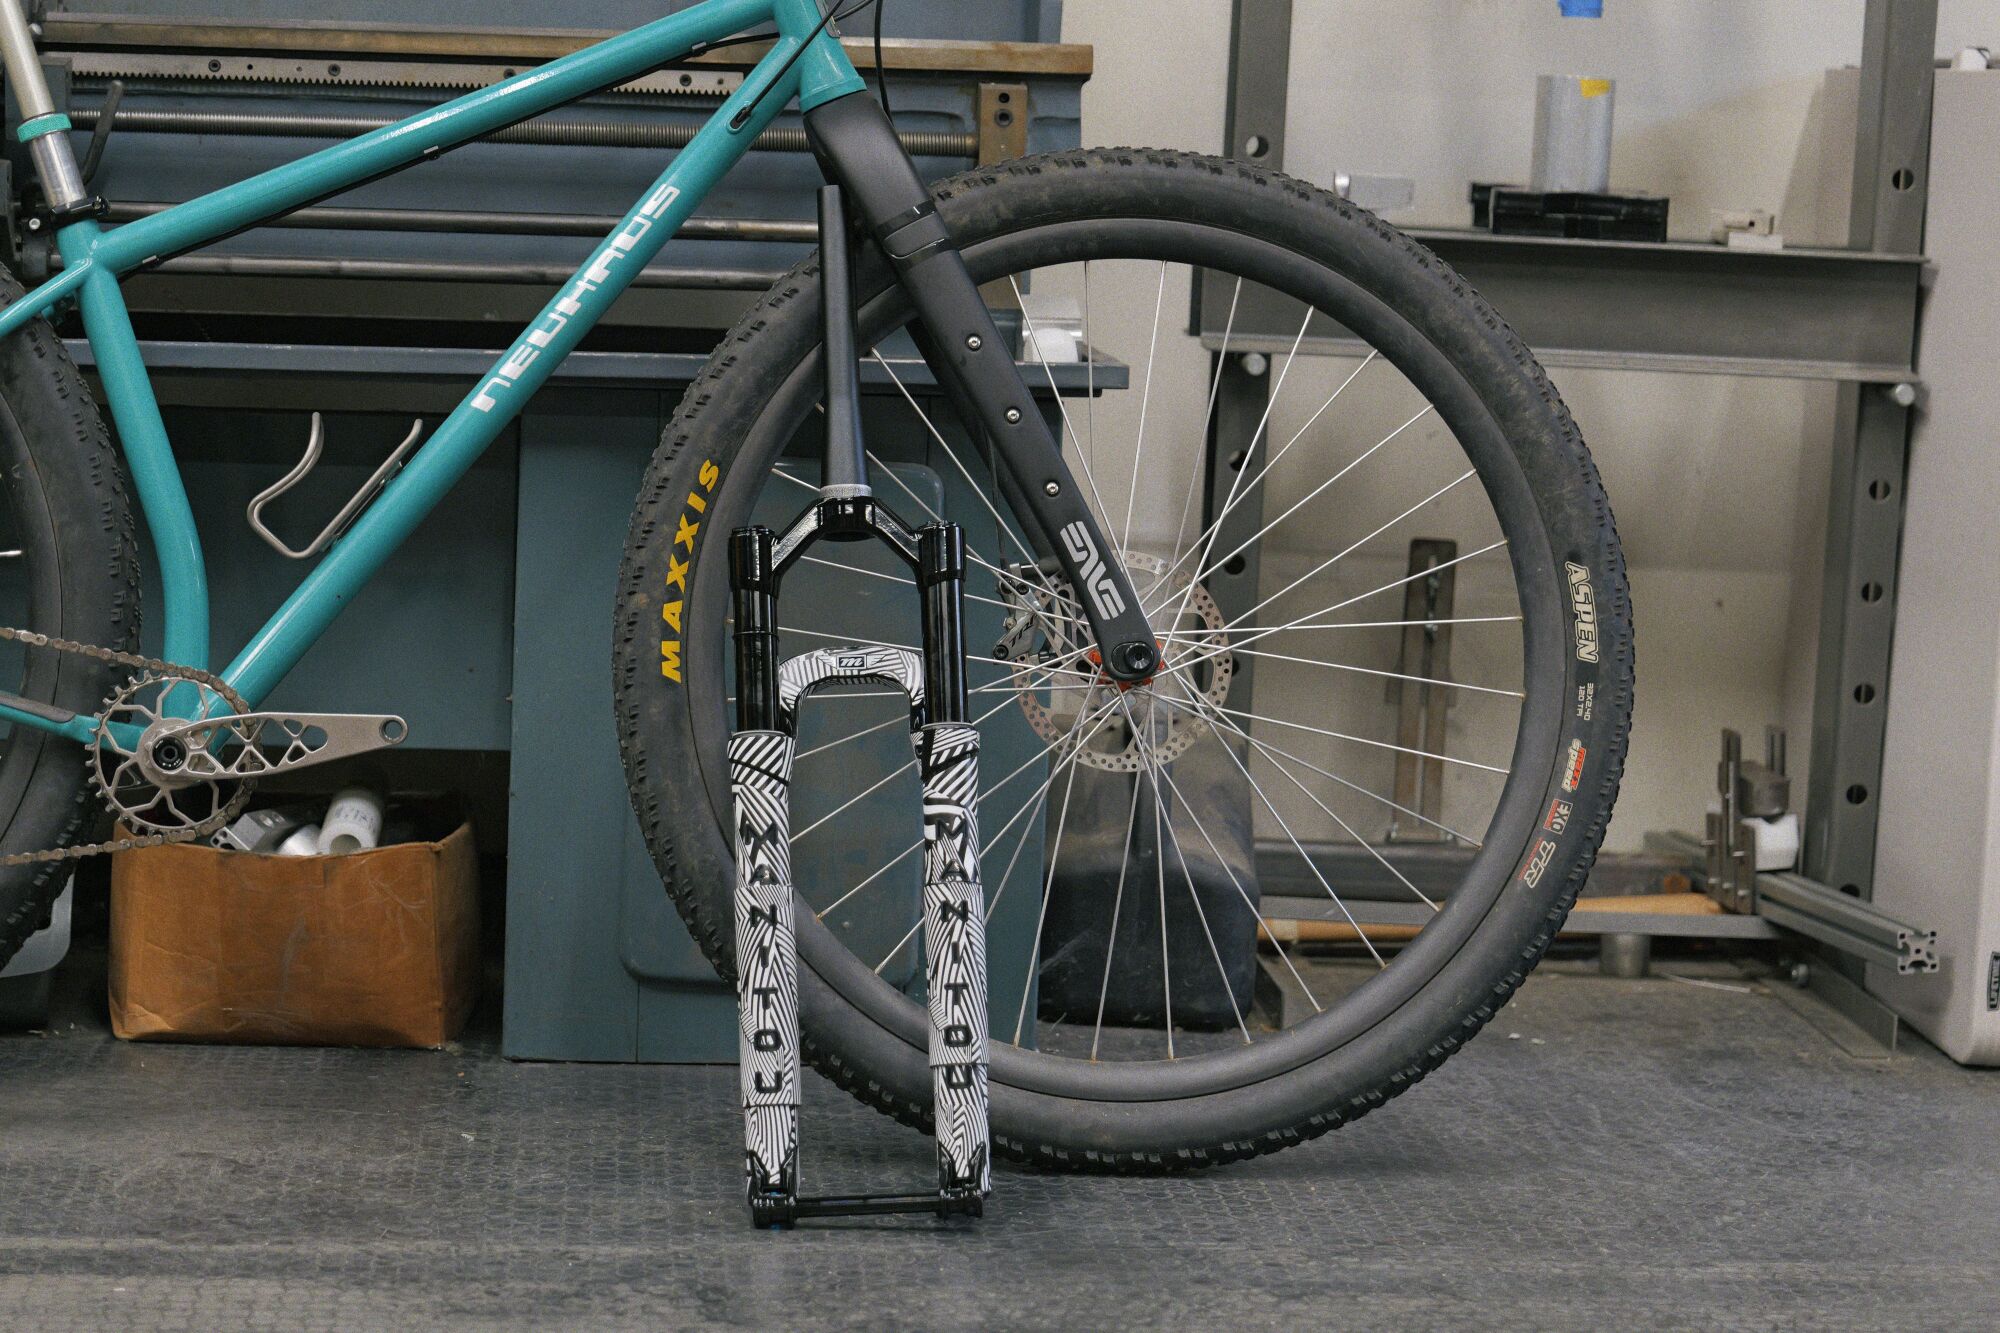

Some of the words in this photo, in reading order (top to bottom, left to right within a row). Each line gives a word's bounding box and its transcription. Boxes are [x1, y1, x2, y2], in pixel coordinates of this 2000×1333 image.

[661, 459, 719, 684] MAXXIS
[1060, 521, 1126, 620] ENVE
[1565, 561, 1598, 664] ASPEN
[1578, 685, 1586, 701] 120
[1583, 682, 1594, 721] 32X2.40
[1524, 841, 1556, 889] TR
[1551, 802, 1571, 833] EXO
[743, 820, 783, 1094] MANITOU
[935, 818, 973, 1091] MANITOU
